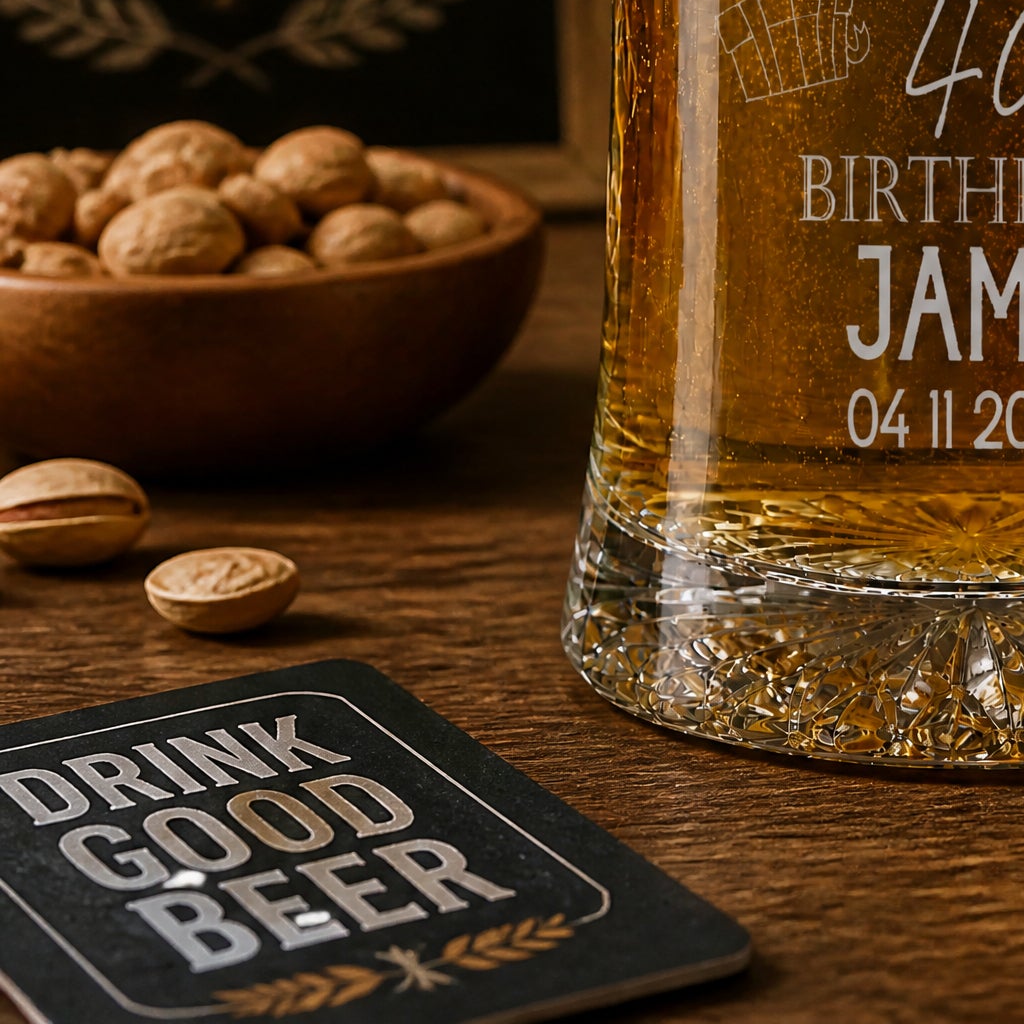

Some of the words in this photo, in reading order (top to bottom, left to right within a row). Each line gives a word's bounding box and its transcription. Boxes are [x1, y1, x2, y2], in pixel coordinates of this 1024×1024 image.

[847, 387, 910, 449] 04
[0, 715, 351, 826] DRINK
[58, 775, 415, 891] GOOD
[126, 839, 516, 973] BEER
